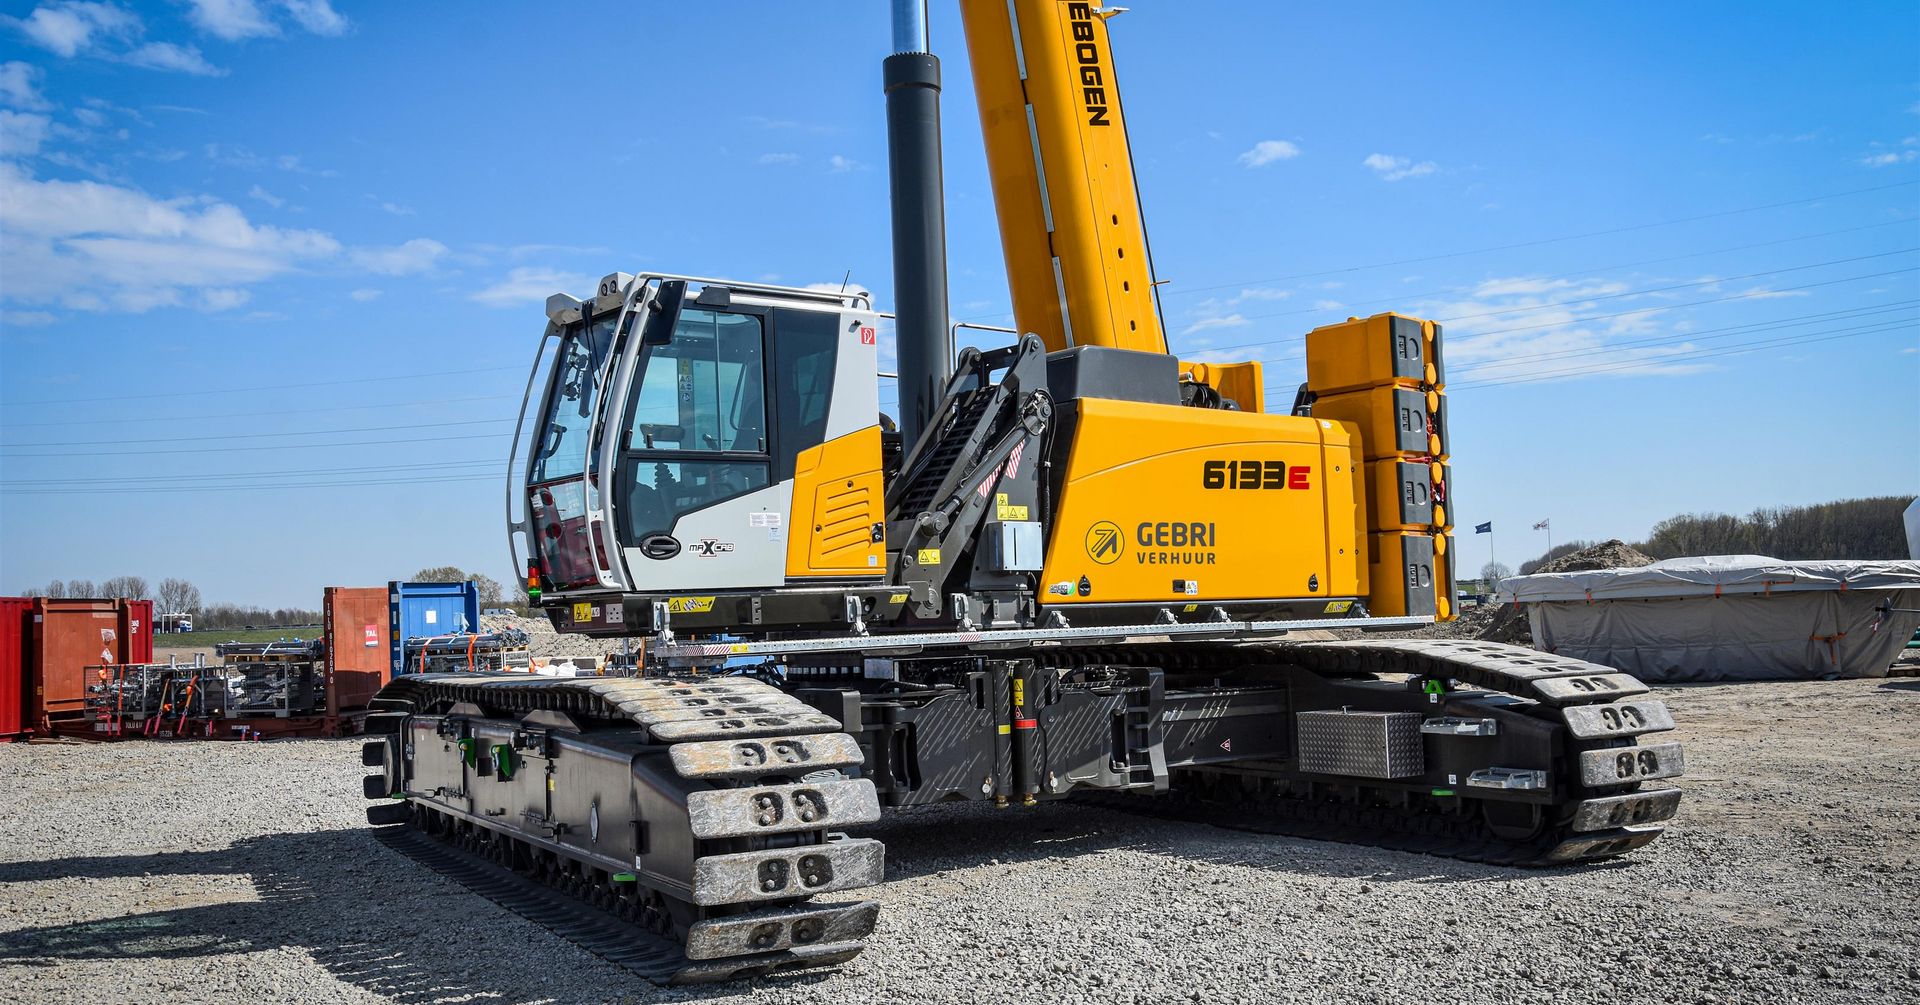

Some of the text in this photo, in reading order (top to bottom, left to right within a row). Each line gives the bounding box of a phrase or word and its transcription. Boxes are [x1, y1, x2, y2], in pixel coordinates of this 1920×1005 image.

[1068, 2, 1110, 127] EBOGEN
[1203, 460, 1311, 490] 6133E
[1137, 522, 1215, 547] GEBRI
[1137, 552, 1216, 565] VERHUUR
